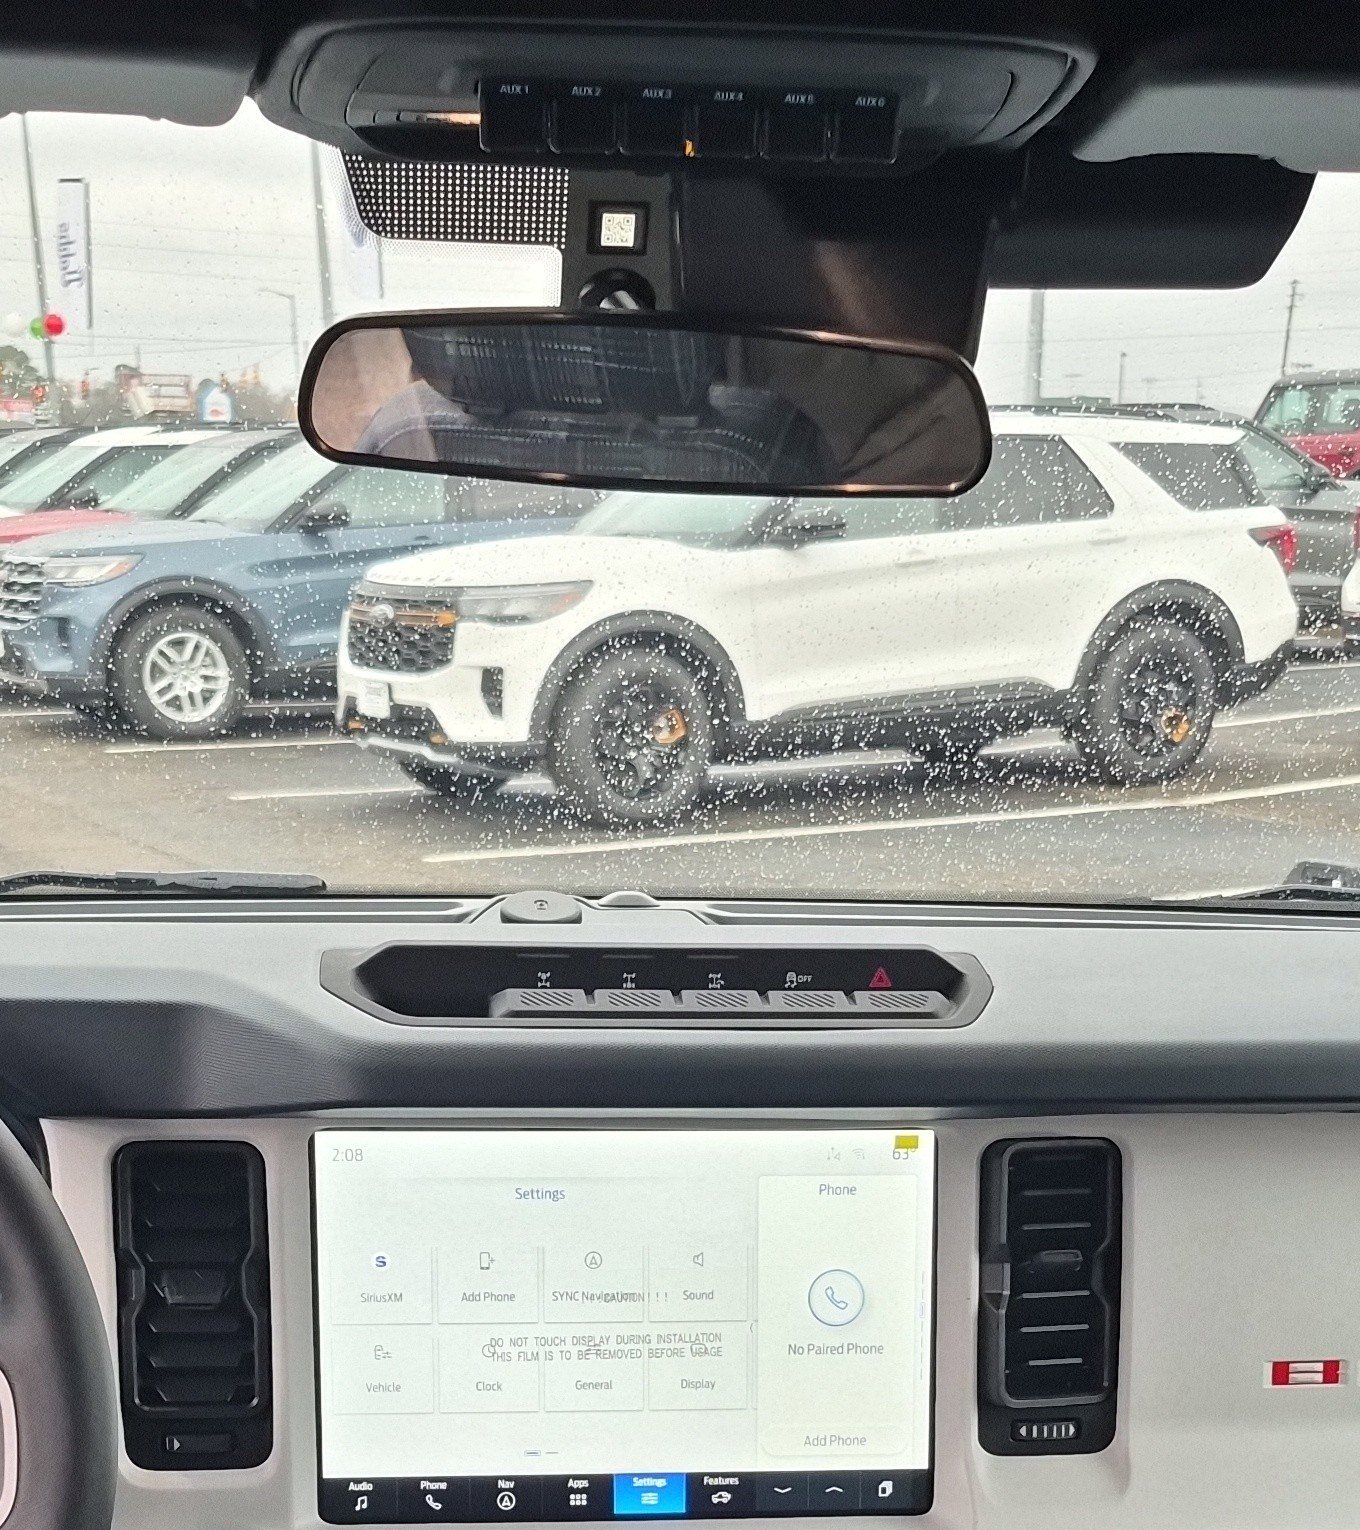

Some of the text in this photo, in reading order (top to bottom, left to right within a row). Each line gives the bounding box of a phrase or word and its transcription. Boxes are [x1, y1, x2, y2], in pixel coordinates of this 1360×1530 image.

[500, 84, 521, 95] AUX
[571, 86, 592, 96] AUX
[643, 88, 664, 99] AUX
[714, 90, 736, 101] AUX
[785, 93, 806, 104] AUX
[855, 96, 877, 107] AUX
[797, 975, 812, 983] OFF
[331, 1148, 363, 1162] 2:08
[514, 1187, 566, 1202] Settings
[818, 1183, 857, 1196] Phone
[360, 1291, 403, 1303] SiriusXM
[461, 1290, 516, 1302] Add Phone
[552, 1291, 579, 1302] SYNC
[682, 1290, 714, 1300] Sound
[490, 1332, 722, 1348] DO NOT TOUCH DISPLAY DURING INSTALLATION
[491, 1351, 512, 1362] THIS
[518, 1350, 539, 1362] FILM
[544, 1350, 554, 1361] IS
[559, 1349, 572, 1361] TO
[577, 1349, 591, 1360] BE
[595, 1348, 642, 1360] REMOVED
[648, 1347, 686, 1359] BEFORE
[788, 1343, 884, 1356] No Paired Phone
[365, 1381, 402, 1394] Vehicle
[475, 1380, 503, 1392] Clock
[575, 1379, 613, 1391] General
[680, 1377, 716, 1391] Display
[803, 1434, 867, 1447] Add Phone
[348, 1480, 373, 1492] Audio
[420, 1480, 447, 1491] Phone
[497, 1479, 515, 1490] Nav
[567, 1478, 589, 1490] Apps
[632, 1475, 667, 1489] Settings
[703, 1475, 739, 1487] Features
